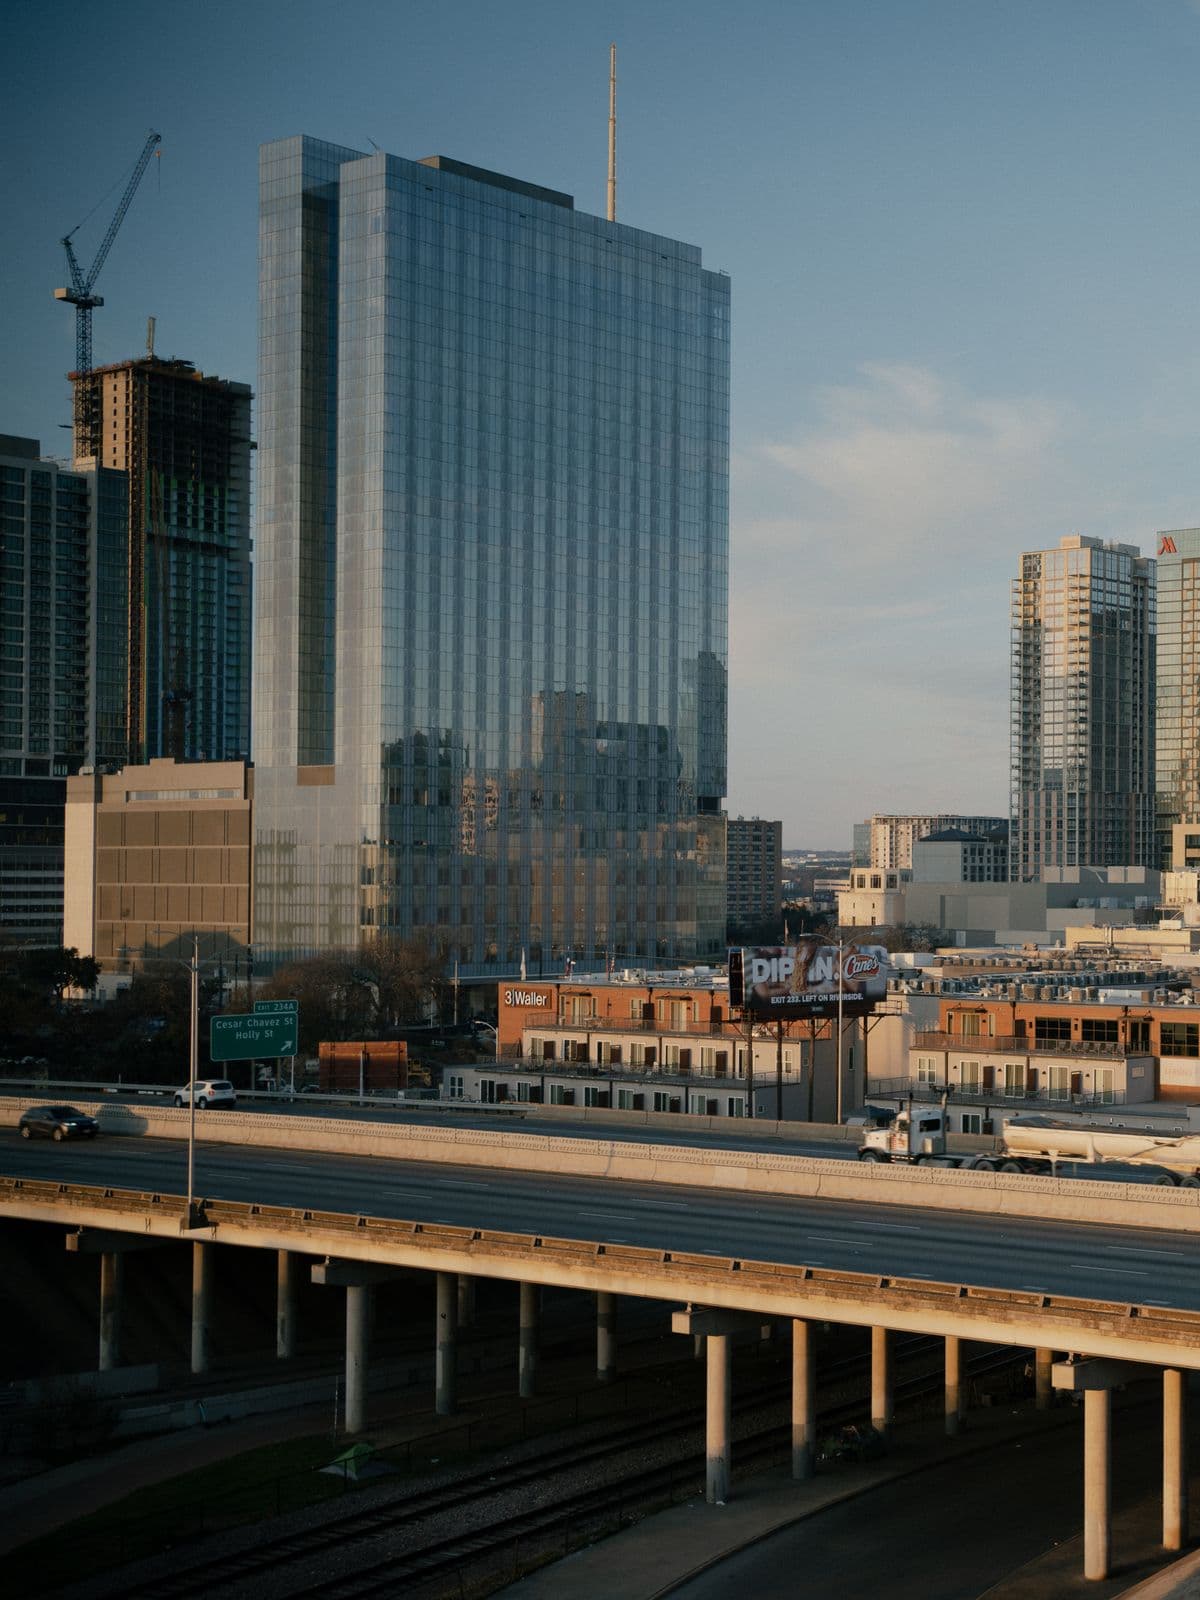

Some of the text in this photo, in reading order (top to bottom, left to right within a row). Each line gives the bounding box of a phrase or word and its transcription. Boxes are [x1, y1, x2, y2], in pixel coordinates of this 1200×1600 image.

[845, 953, 879, 979] Cane's
[771, 996, 785, 1004] EXIT
[802, 994, 816, 1002] LEFT
[273, 1003, 295, 1011] 234A
[215, 1017, 293, 1029] Cesar Chavez St
[235, 1030, 273, 1040] Holly St
